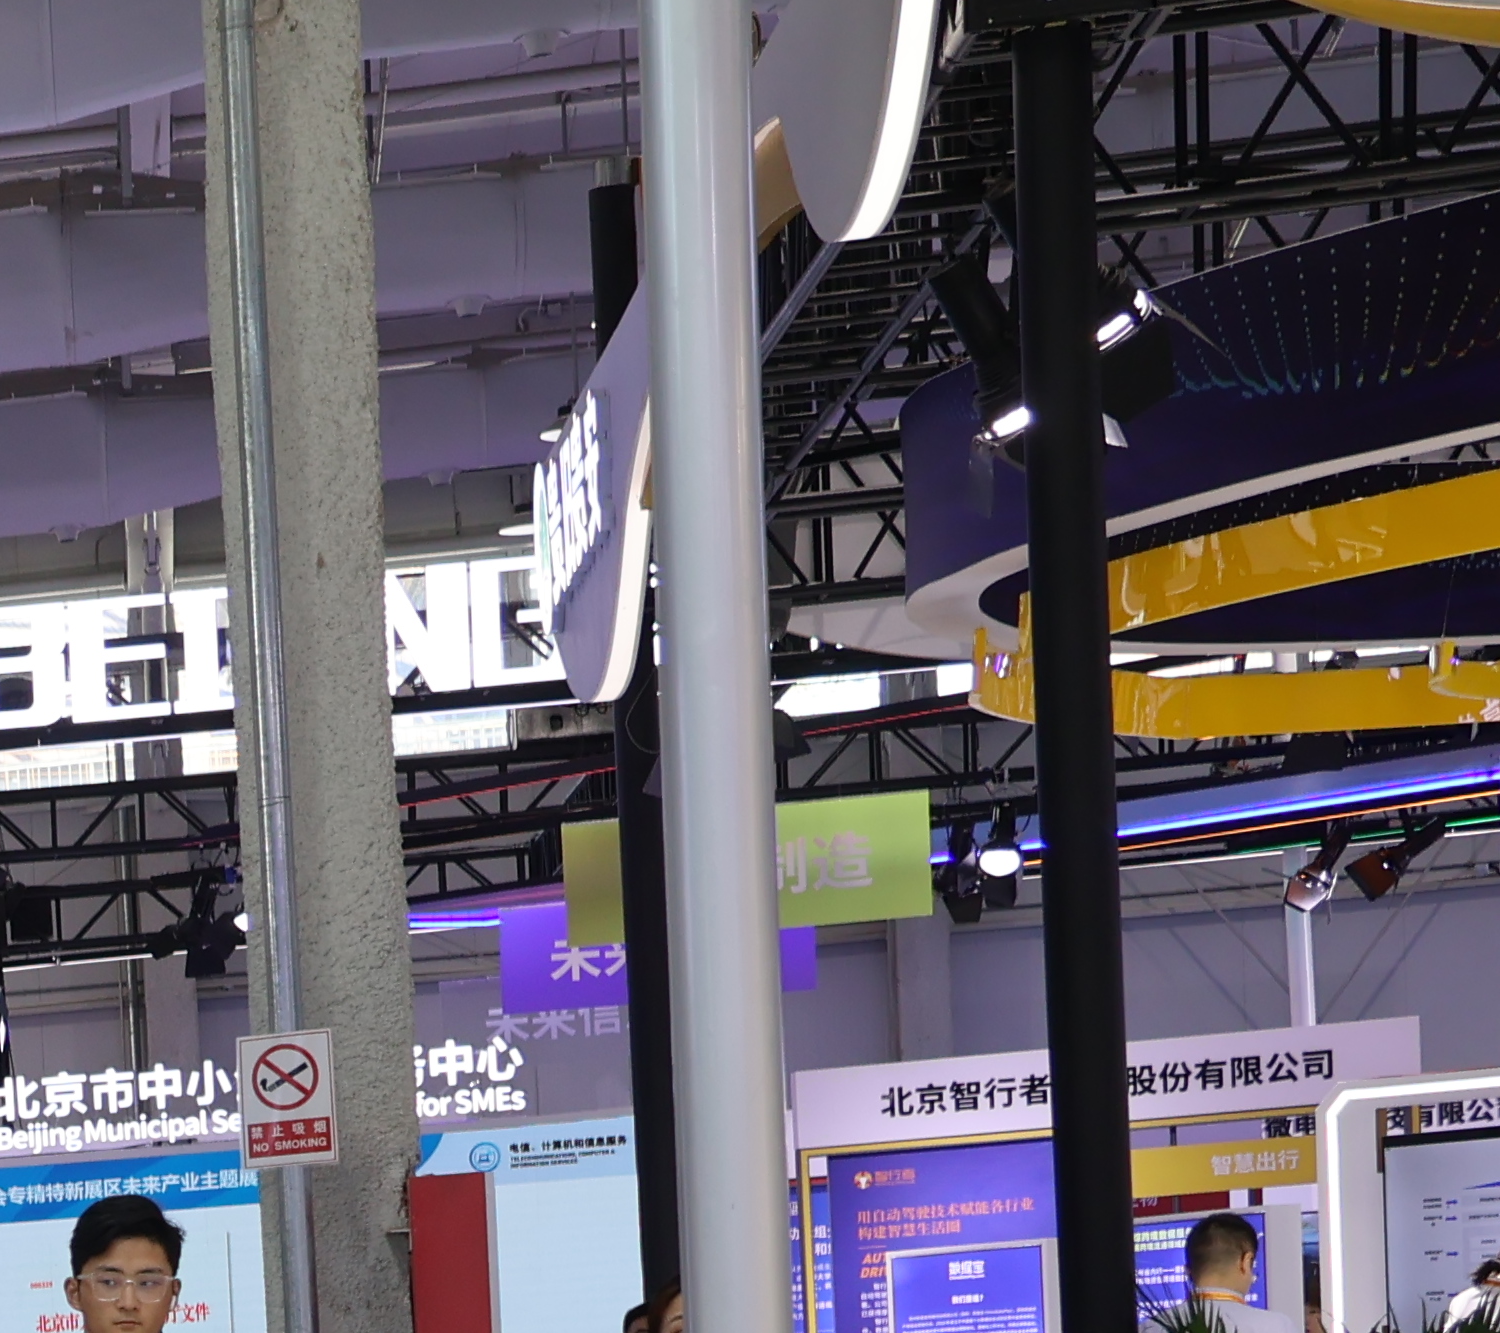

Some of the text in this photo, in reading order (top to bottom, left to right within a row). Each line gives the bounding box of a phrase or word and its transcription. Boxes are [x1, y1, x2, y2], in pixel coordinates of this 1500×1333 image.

[485, 1004, 629, 1044] 未来信
[84, 1108, 209, 1144] Municipal
[455, 1086, 527, 1115] SMEs
[250, 1119, 328, 1140] 禁止吸烟
[252, 1136, 328, 1154] NO SMOKING
[1211, 1149, 1300, 1177] 智慧出行
